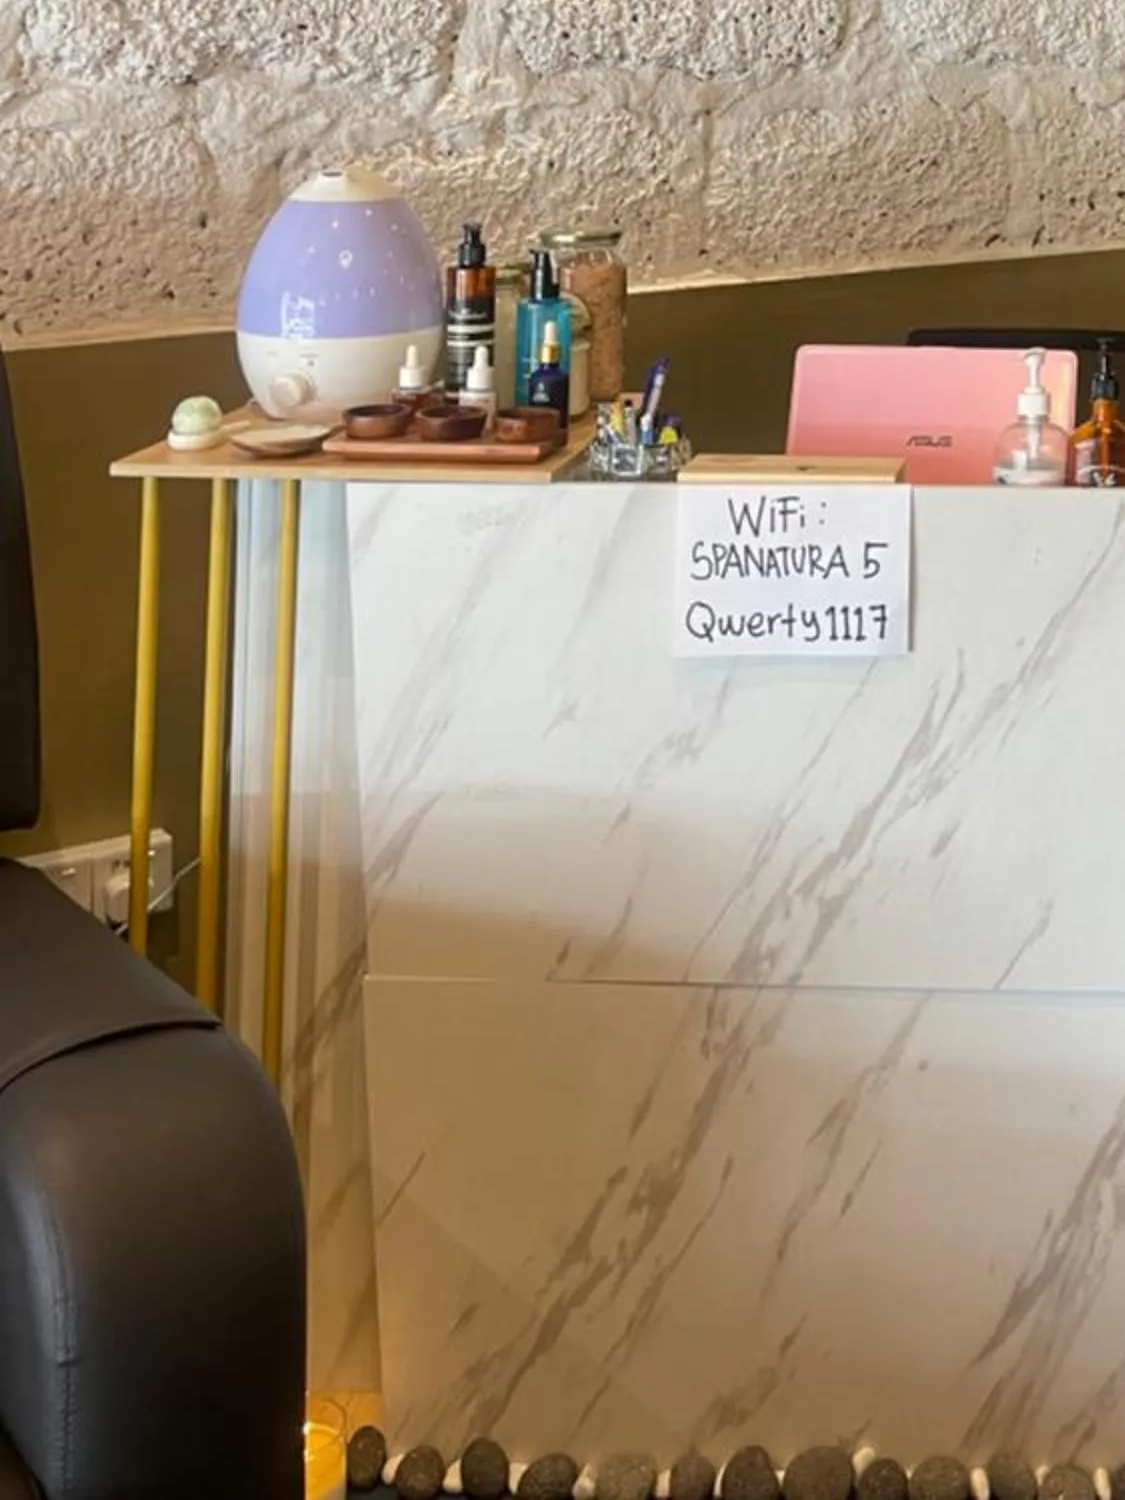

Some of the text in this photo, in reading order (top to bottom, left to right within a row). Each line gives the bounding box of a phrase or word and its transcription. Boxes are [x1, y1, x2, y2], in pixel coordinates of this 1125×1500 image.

[906, 435, 953, 448] ASUS
[690, 541, 850, 581] SPANATURA
[685, 601, 889, 643] Qwerty1117
